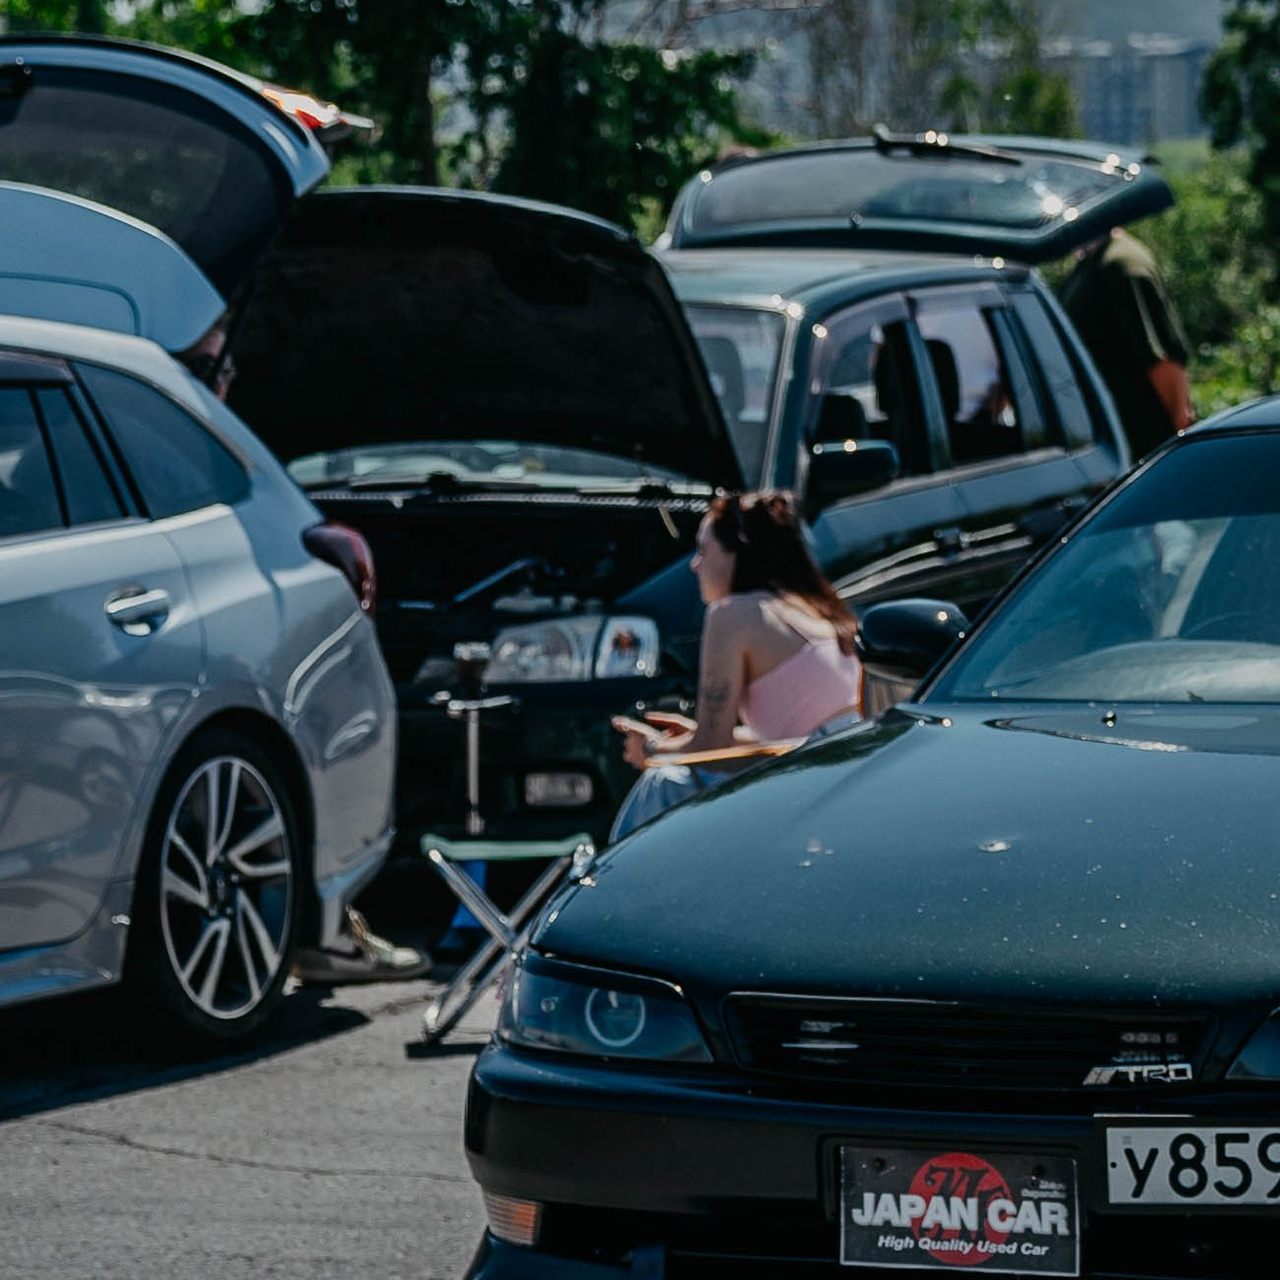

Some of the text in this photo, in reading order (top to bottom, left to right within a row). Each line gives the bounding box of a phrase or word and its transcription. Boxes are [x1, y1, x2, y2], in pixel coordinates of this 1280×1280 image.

[851, 1192, 1070, 1236] JAPAN CAR
[877, 1235, 1050, 1256] High Quality Used Car
